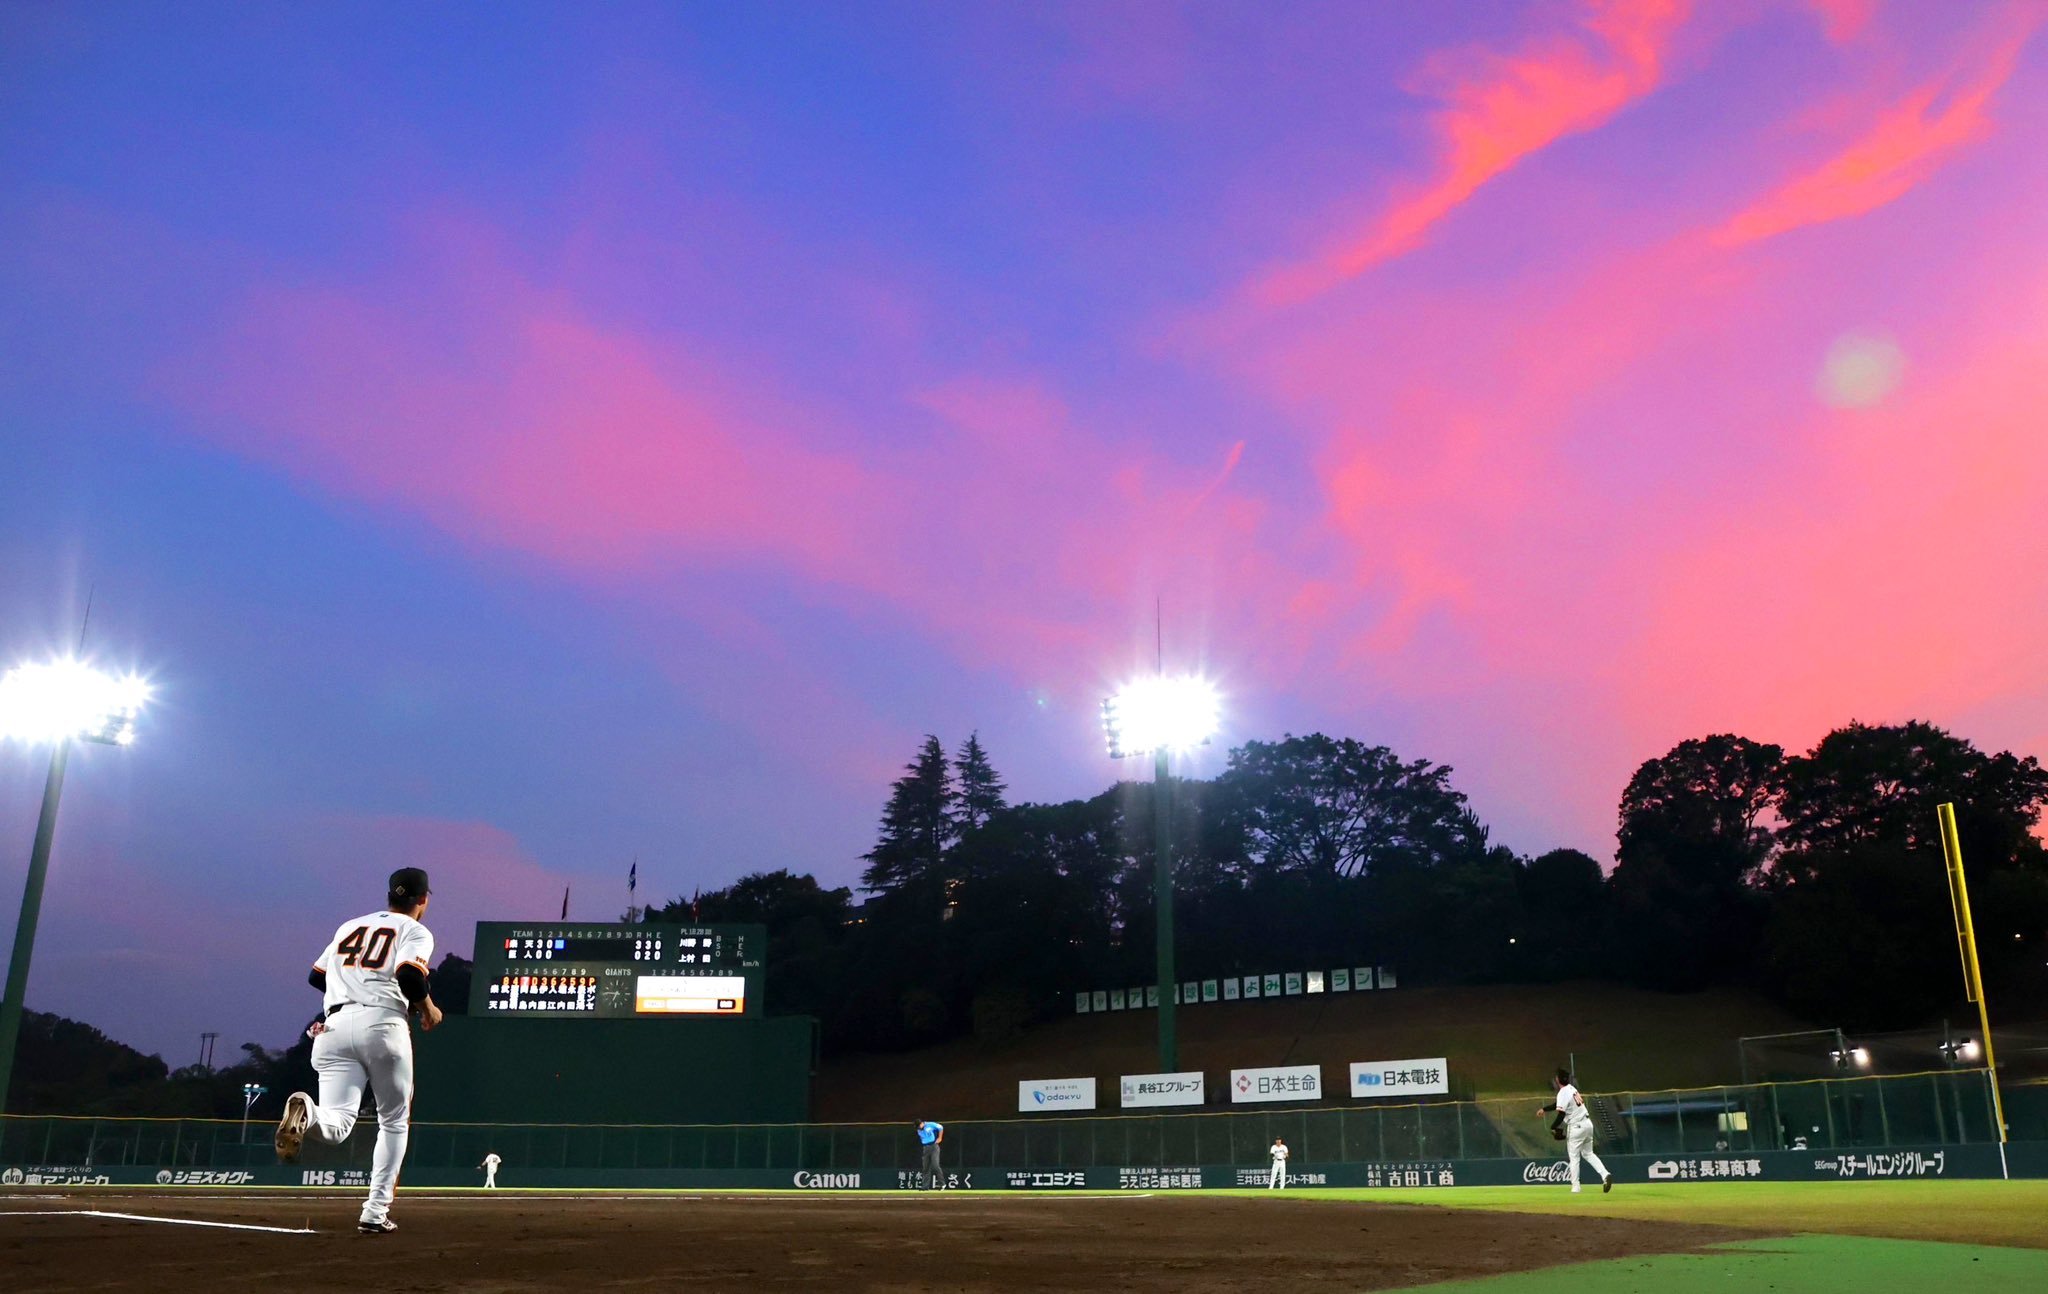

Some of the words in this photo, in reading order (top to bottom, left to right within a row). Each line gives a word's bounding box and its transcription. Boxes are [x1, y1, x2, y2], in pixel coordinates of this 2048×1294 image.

[337, 926, 396, 970] 40
[537, 940, 543, 949] 3
[546, 940, 553, 949] 0
[635, 940, 642, 950] 3
[645, 940, 652, 950] 3
[655, 940, 661, 950] 0
[536, 950, 542, 959] 0
[545, 950, 552, 959] 0
[634, 951, 641, 960] 0
[644, 951, 651, 960] 2
[654, 951, 661, 960] 0
[1228, 987, 1236, 995] in
[1258, 1074, 1316, 1093] 日本生命
[1384, 1068, 1440, 1086] 日本電技
[1138, 1080, 1201, 1094] 長谷工グループ
[1700, 1159, 1761, 1177] 長澤商事
[1838, 1151, 1944, 1176] スチールエンジグループ
[173, 1171, 254, 1184] シミズオクト
[302, 1170, 336, 1185] IHS
[794, 1170, 860, 1188] Canon
[1032, 1172, 1085, 1186] エコミナミ
[1120, 1175, 1202, 1188] うえはら歯科医院
[1388, 1170, 1454, 1187] 吉田工商
